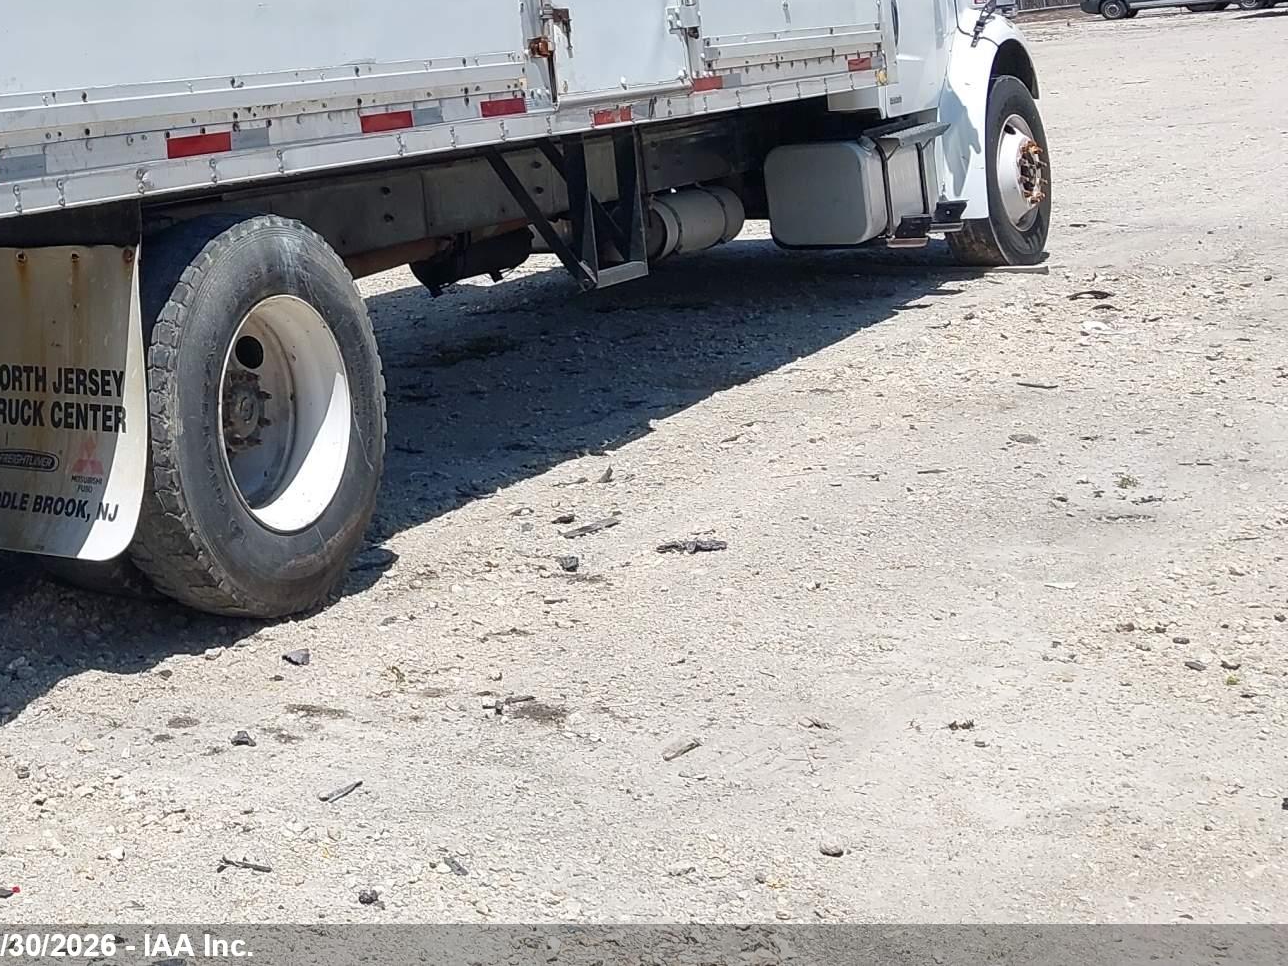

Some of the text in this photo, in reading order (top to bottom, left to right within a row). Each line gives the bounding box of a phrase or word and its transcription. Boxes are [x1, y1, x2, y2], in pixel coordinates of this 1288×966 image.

[52, 367, 124, 397] JERSEY
[50, 401, 126, 433] CENTER
[31, 494, 91, 522] BROOK,
[96, 502, 120, 522] NJ
